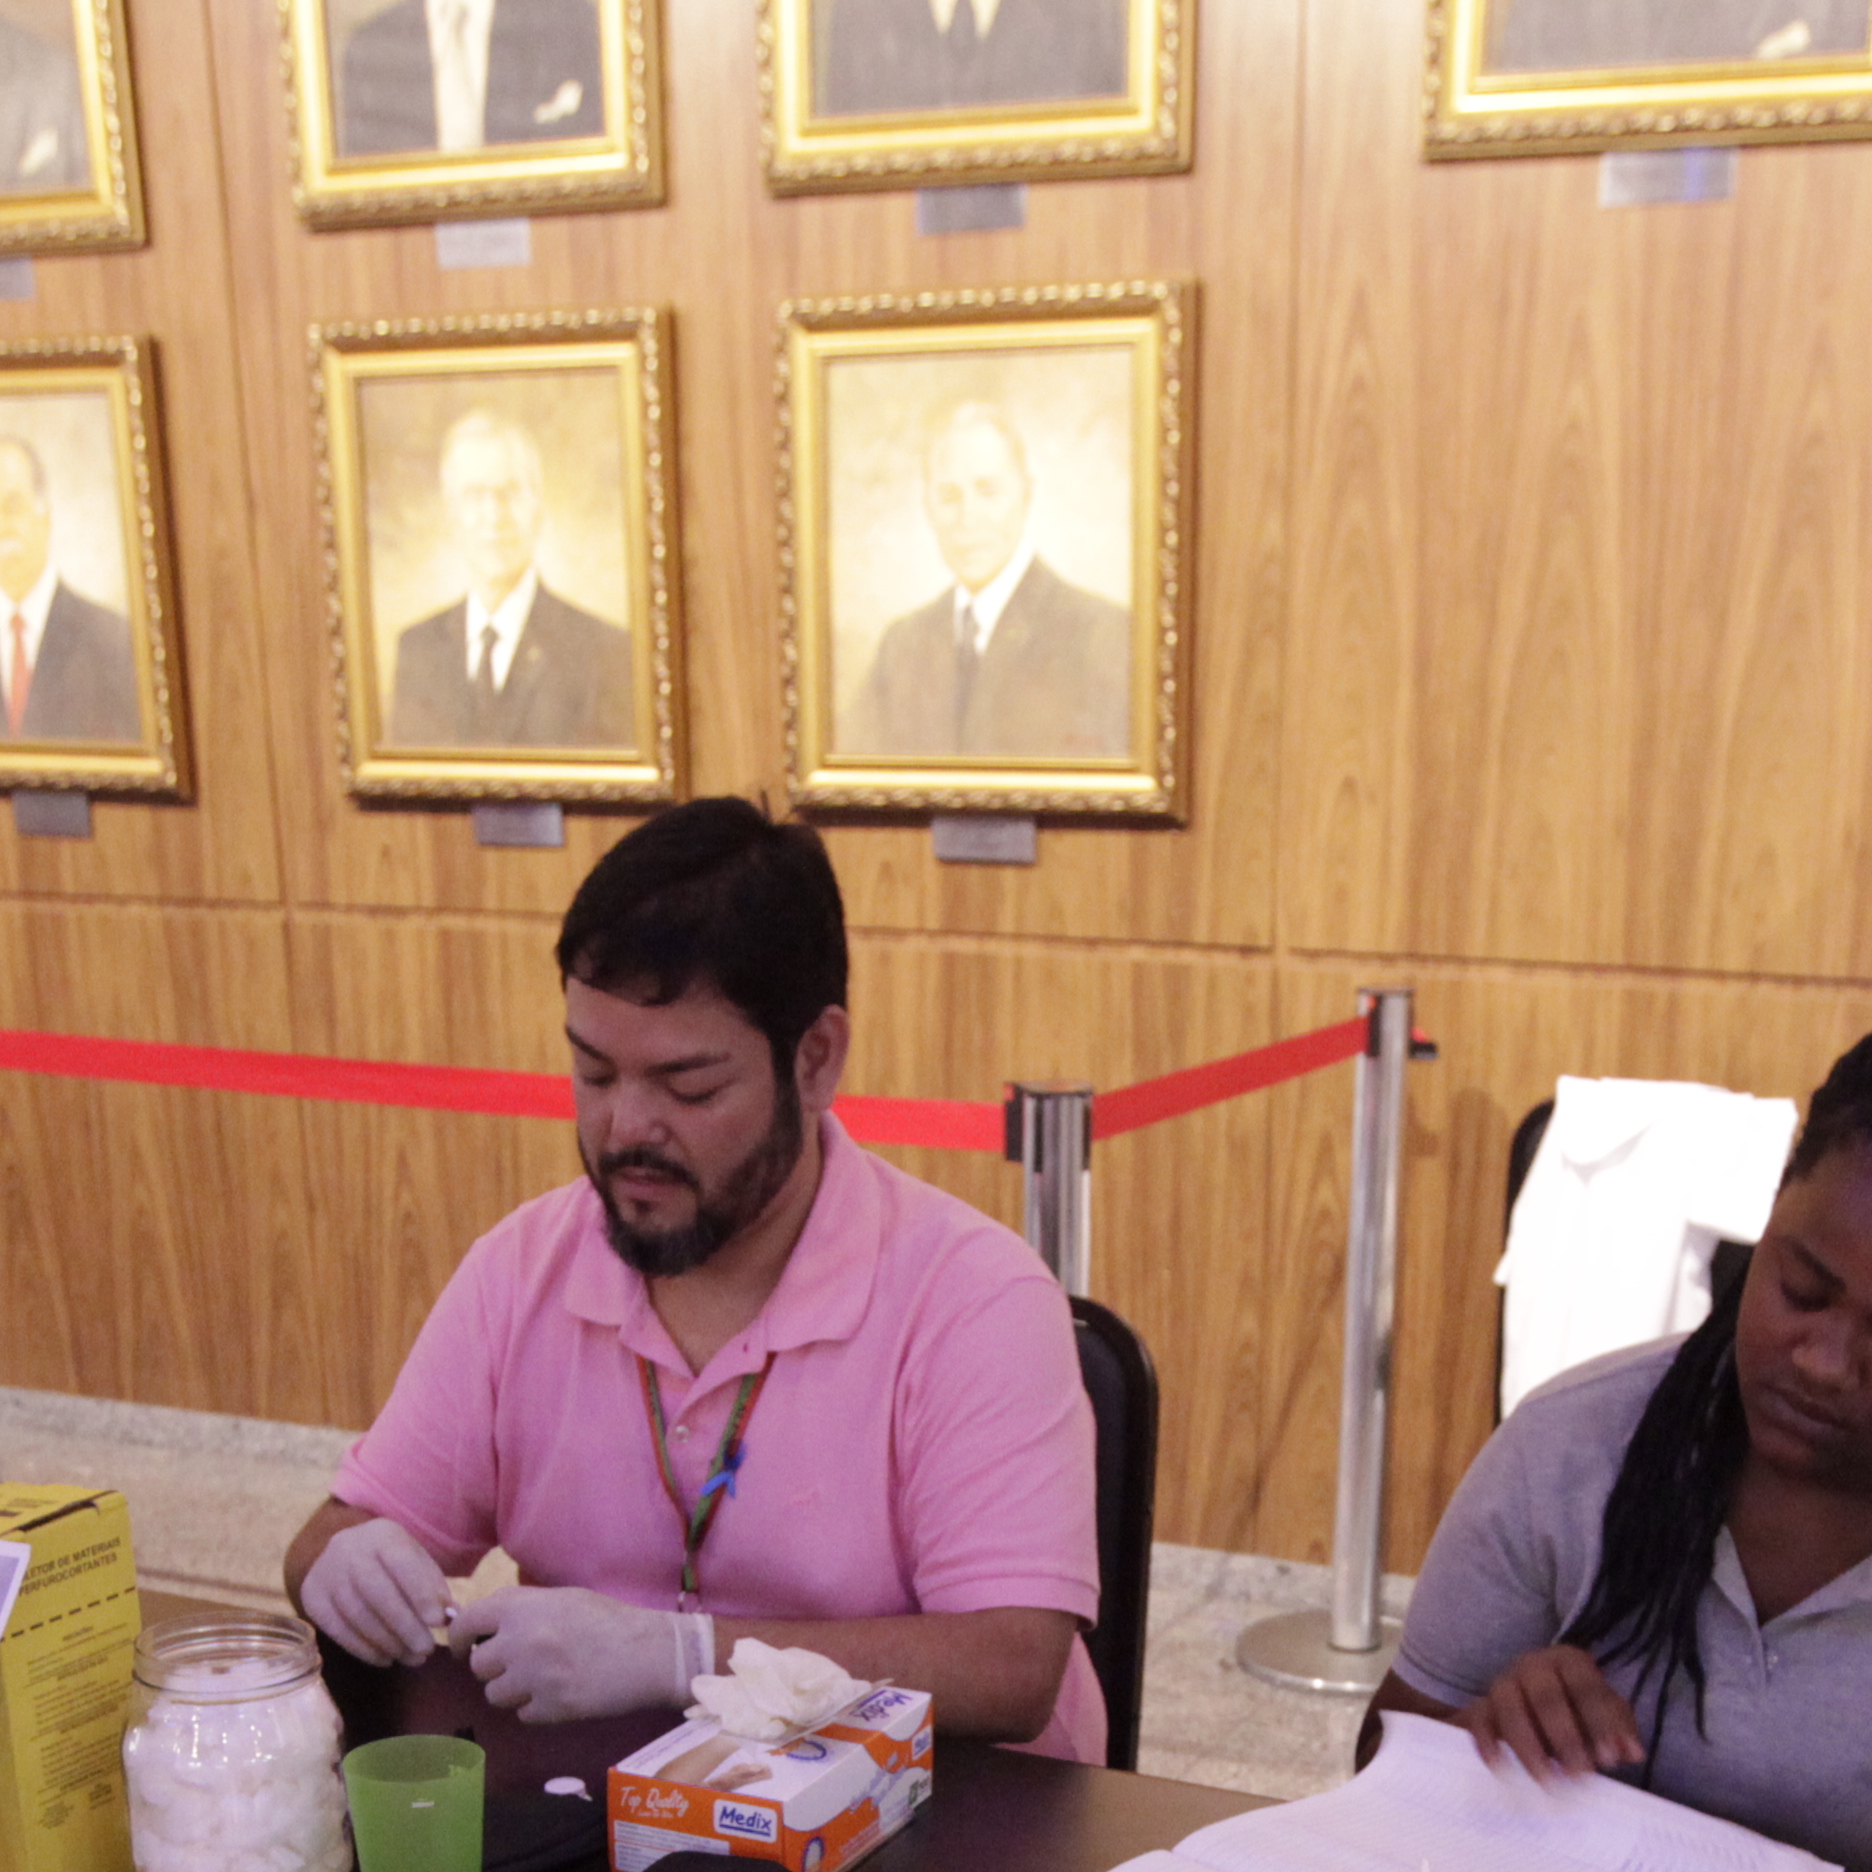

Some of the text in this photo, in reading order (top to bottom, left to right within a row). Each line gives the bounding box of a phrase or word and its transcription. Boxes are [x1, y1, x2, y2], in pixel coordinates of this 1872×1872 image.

[24, 1537, 121, 1581] LETOR DE MATERIAIS
[620, 1786, 690, 1818] Top Quality
[719, 1805, 773, 1833] Medix
